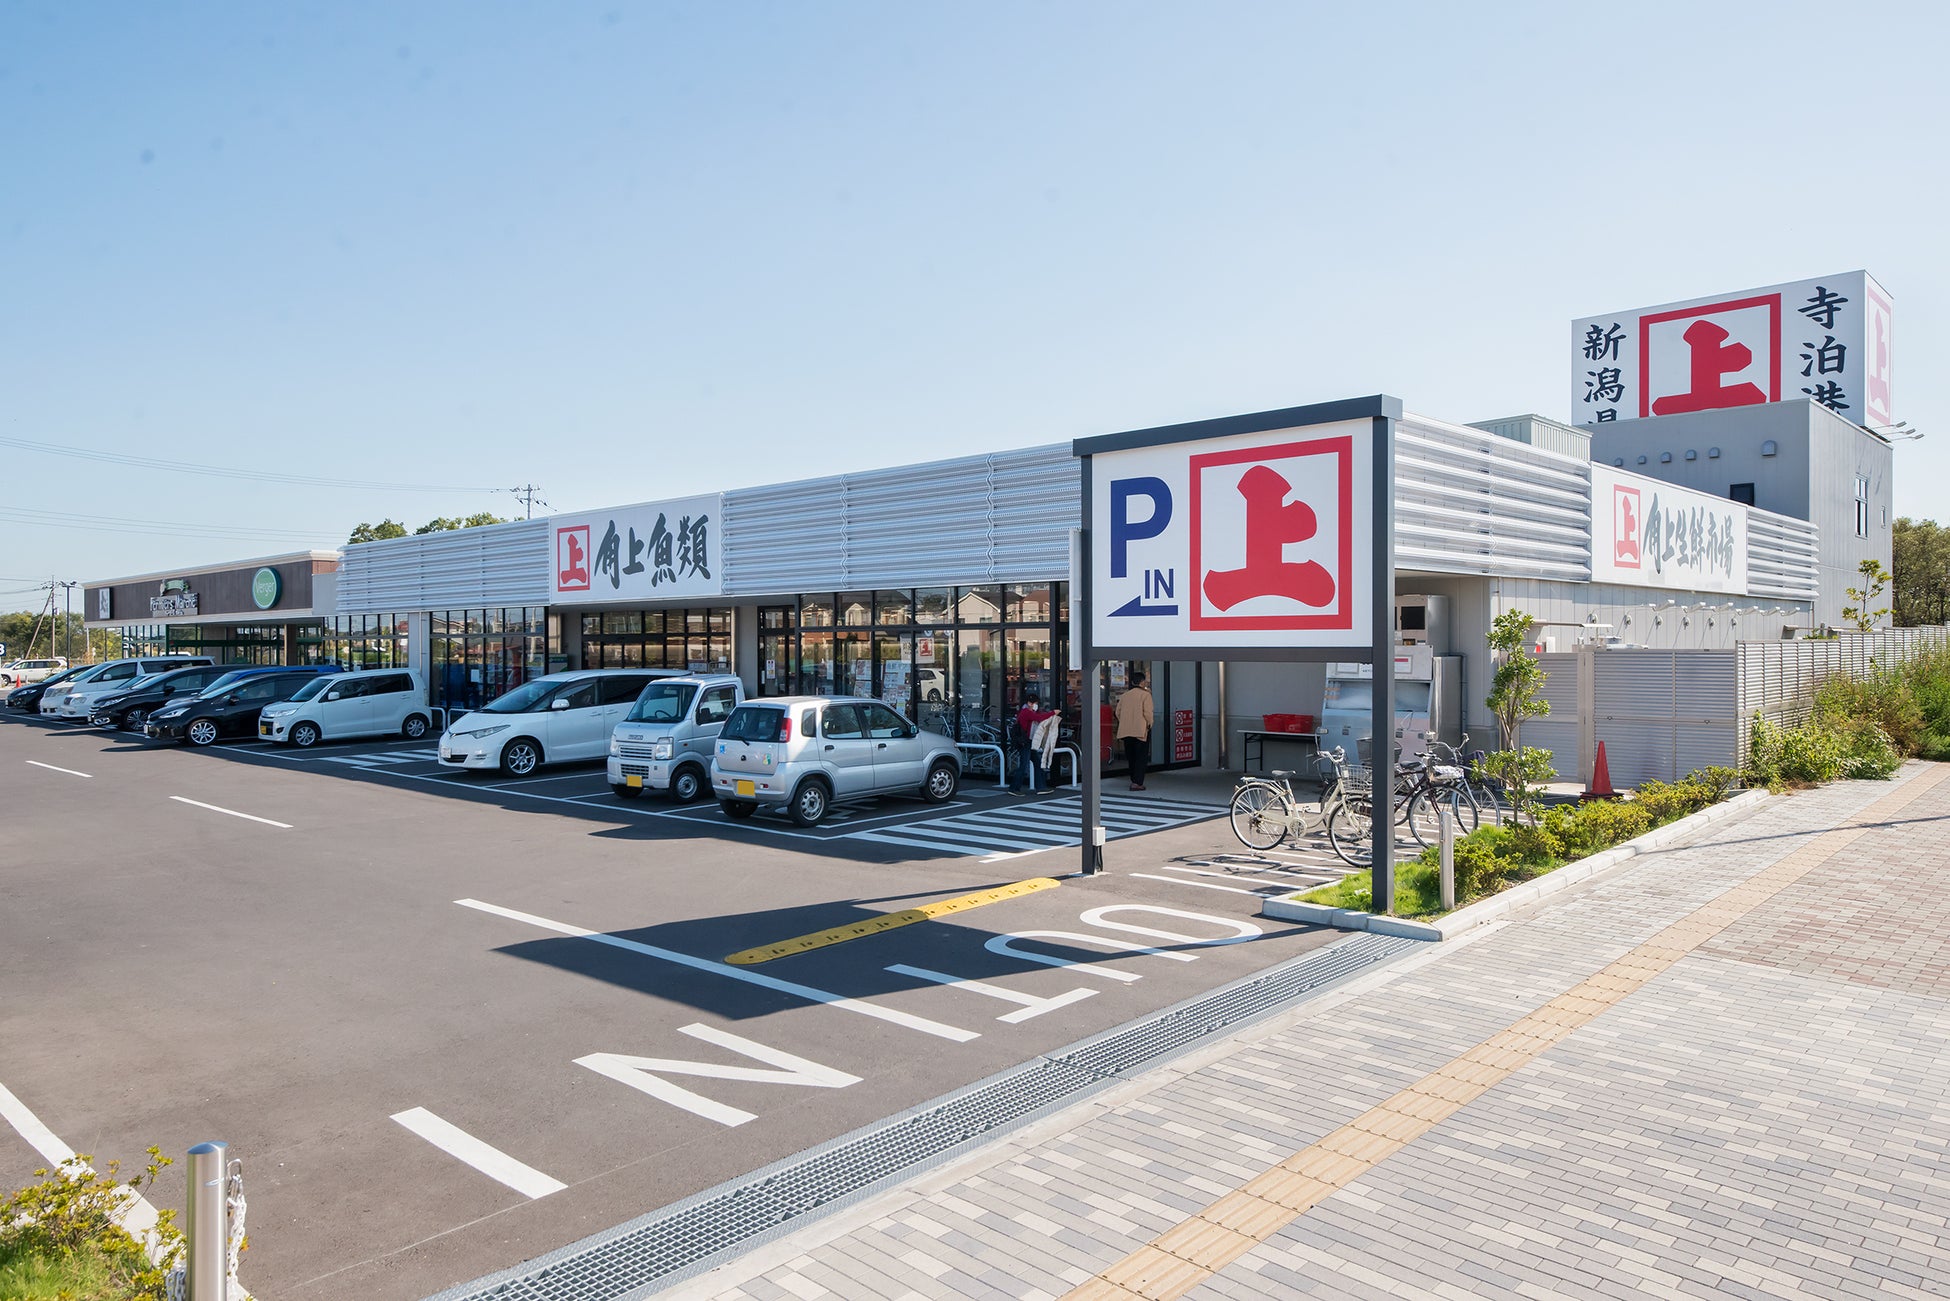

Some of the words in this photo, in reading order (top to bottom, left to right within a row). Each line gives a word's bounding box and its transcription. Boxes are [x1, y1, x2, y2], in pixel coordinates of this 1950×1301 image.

[1652, 320, 1767, 416] 上
[594, 512, 711, 590] 角上魚類
[1110, 476, 1173, 579] P
[1203, 465, 1336, 612] 上
[1144, 568, 1174, 600] IN
